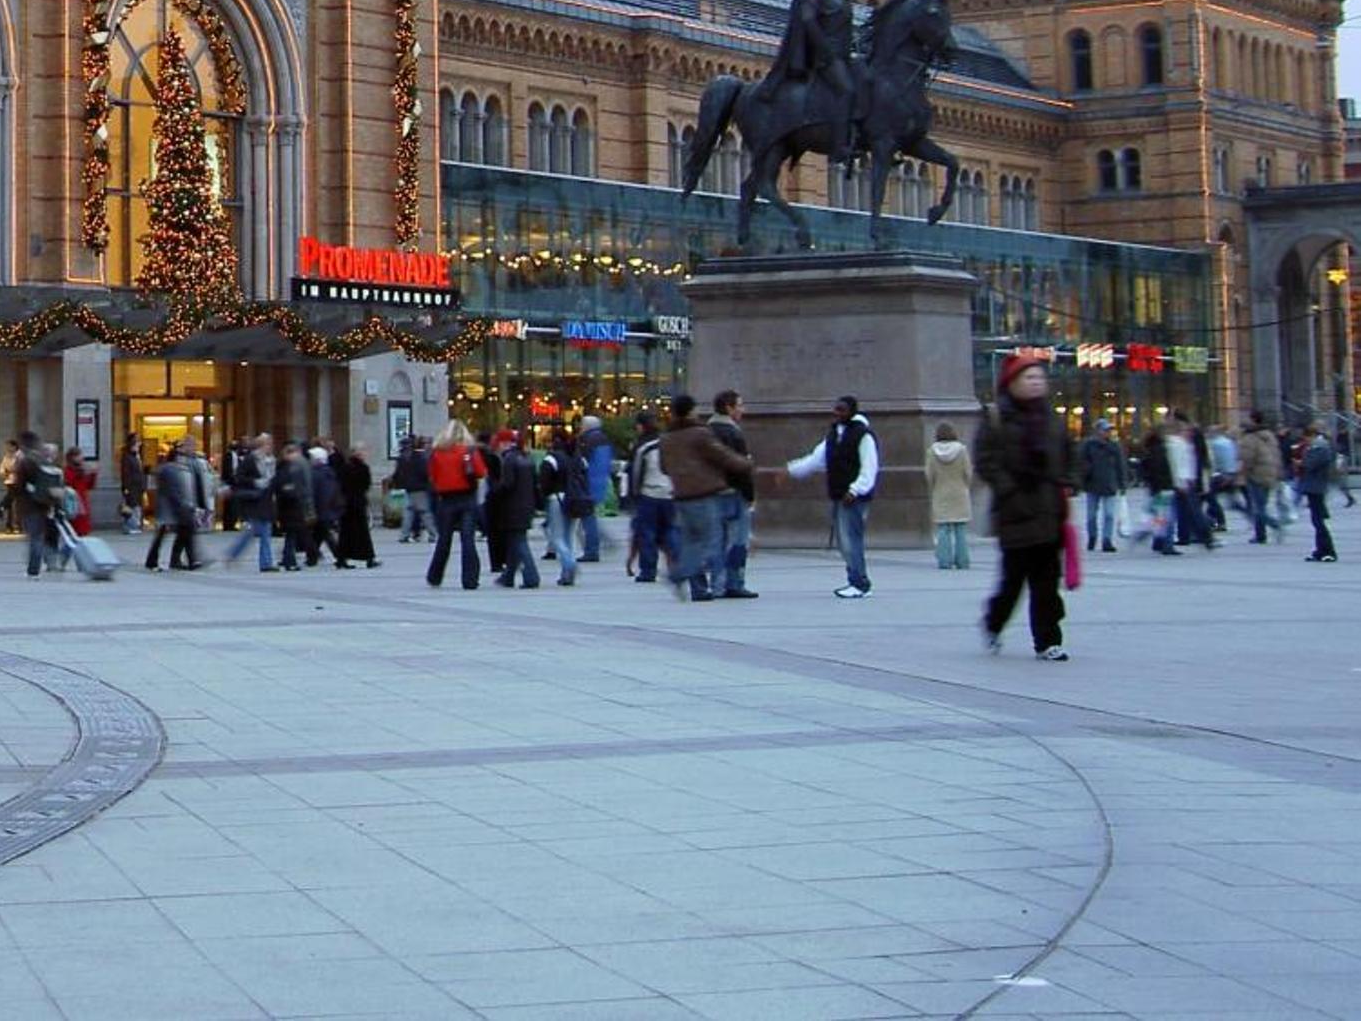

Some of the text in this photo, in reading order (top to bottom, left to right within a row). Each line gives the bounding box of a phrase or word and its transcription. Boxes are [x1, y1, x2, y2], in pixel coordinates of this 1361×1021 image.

[299, 236, 451, 287] PROMENADE
[300, 284, 452, 306] IM HAUPTBAHNHOF
